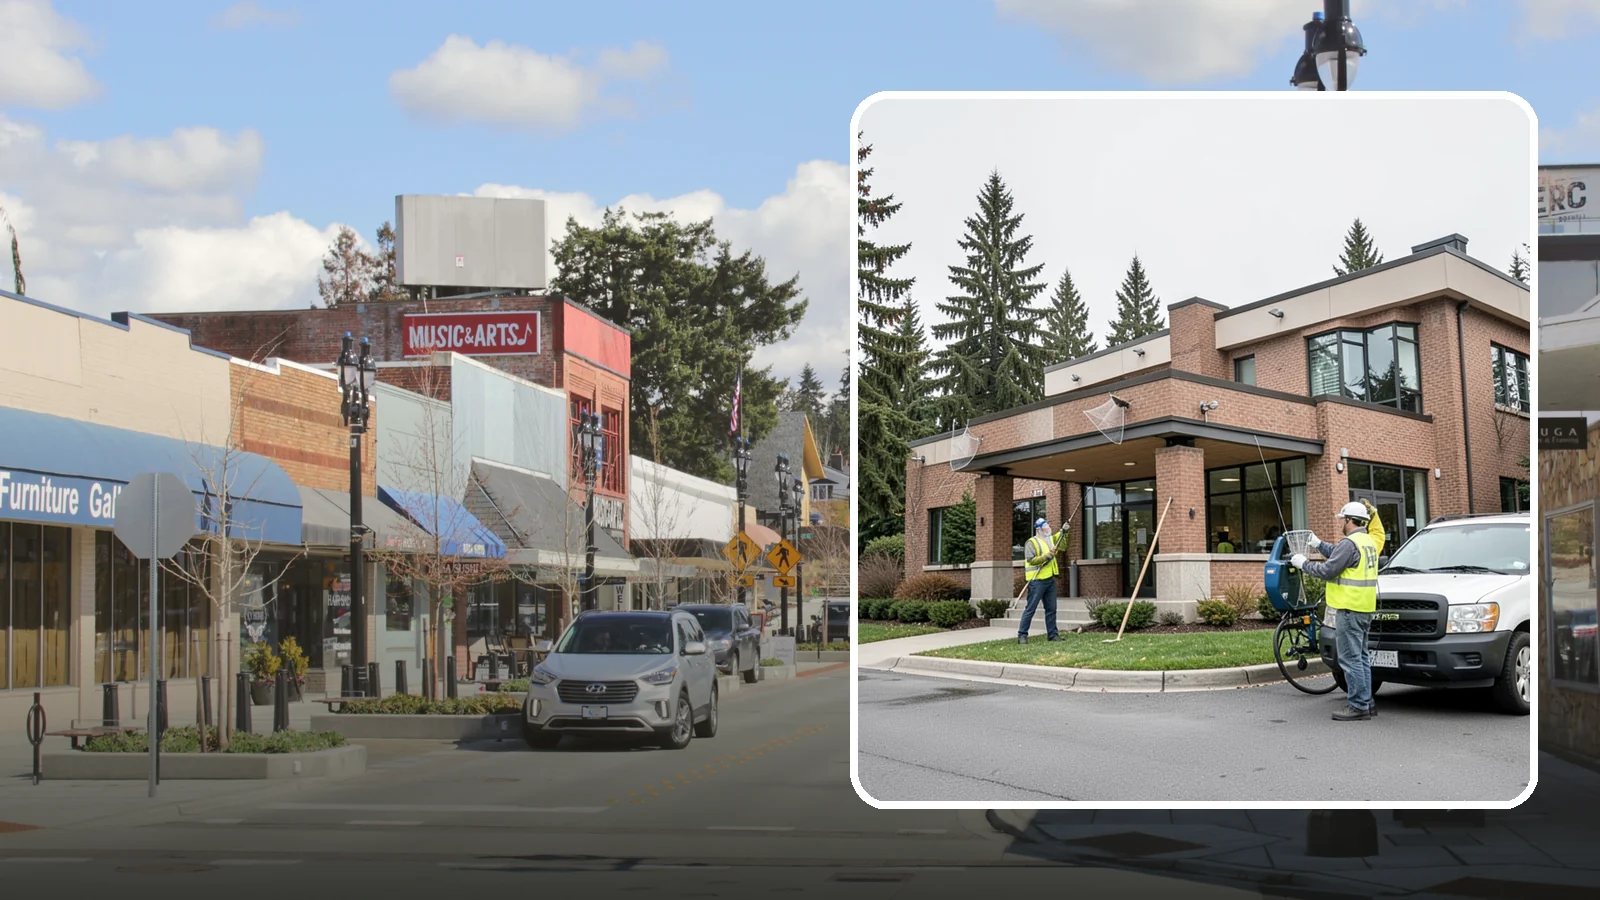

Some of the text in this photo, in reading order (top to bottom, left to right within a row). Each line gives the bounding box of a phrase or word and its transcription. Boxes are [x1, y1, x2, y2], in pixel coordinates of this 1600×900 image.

[1540, 427, 1577, 437] UGA
[0, 471, 121, 519] Furniture Gal
